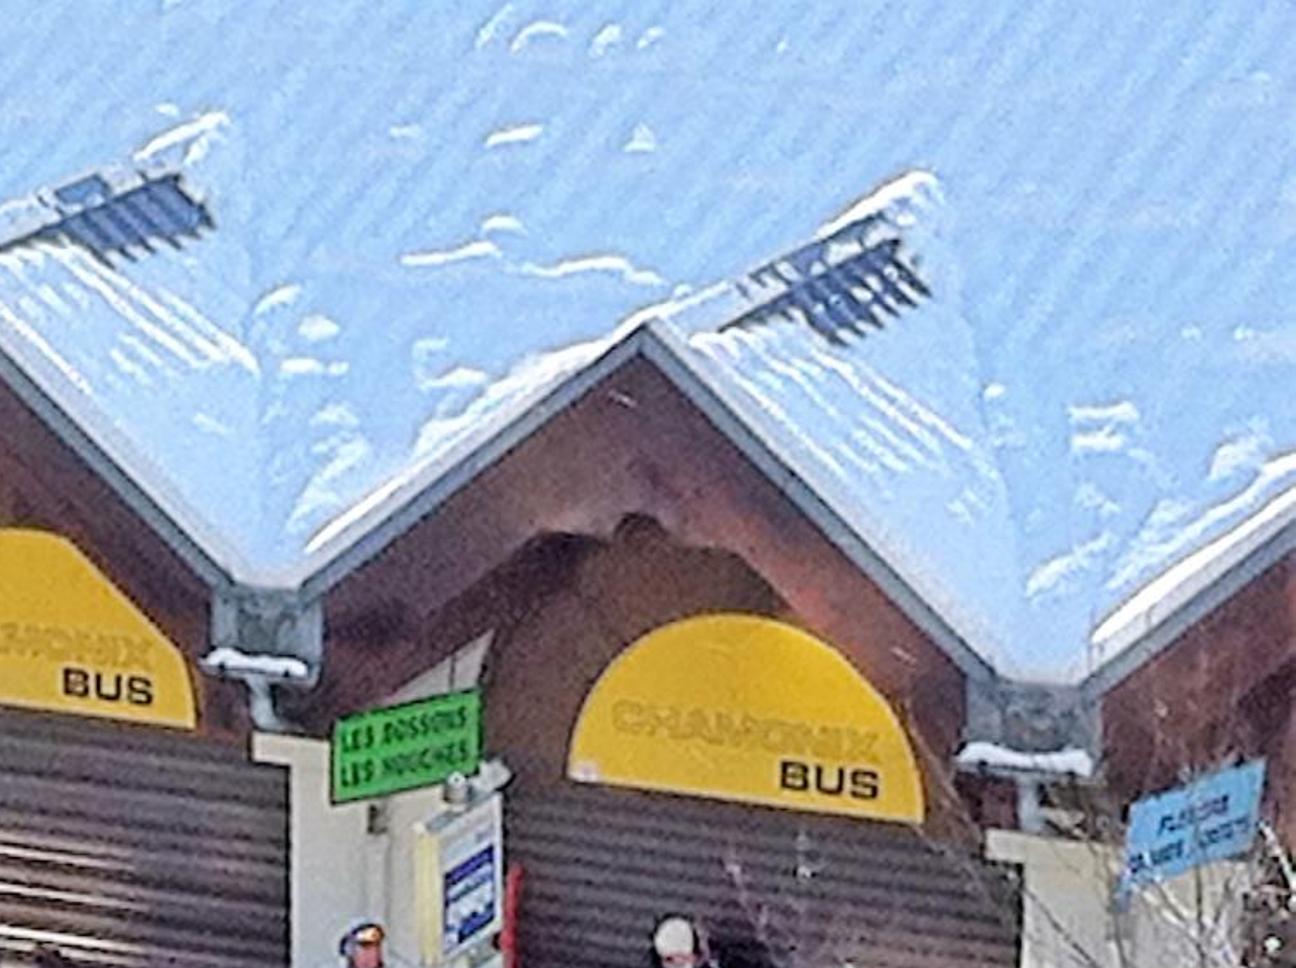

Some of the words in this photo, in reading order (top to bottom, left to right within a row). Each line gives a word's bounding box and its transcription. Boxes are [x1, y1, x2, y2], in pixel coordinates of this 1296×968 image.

[62, 667, 154, 706] BUS
[341, 725, 375, 753] LES
[341, 758, 375, 787] LES
[780, 760, 879, 799] BUS
